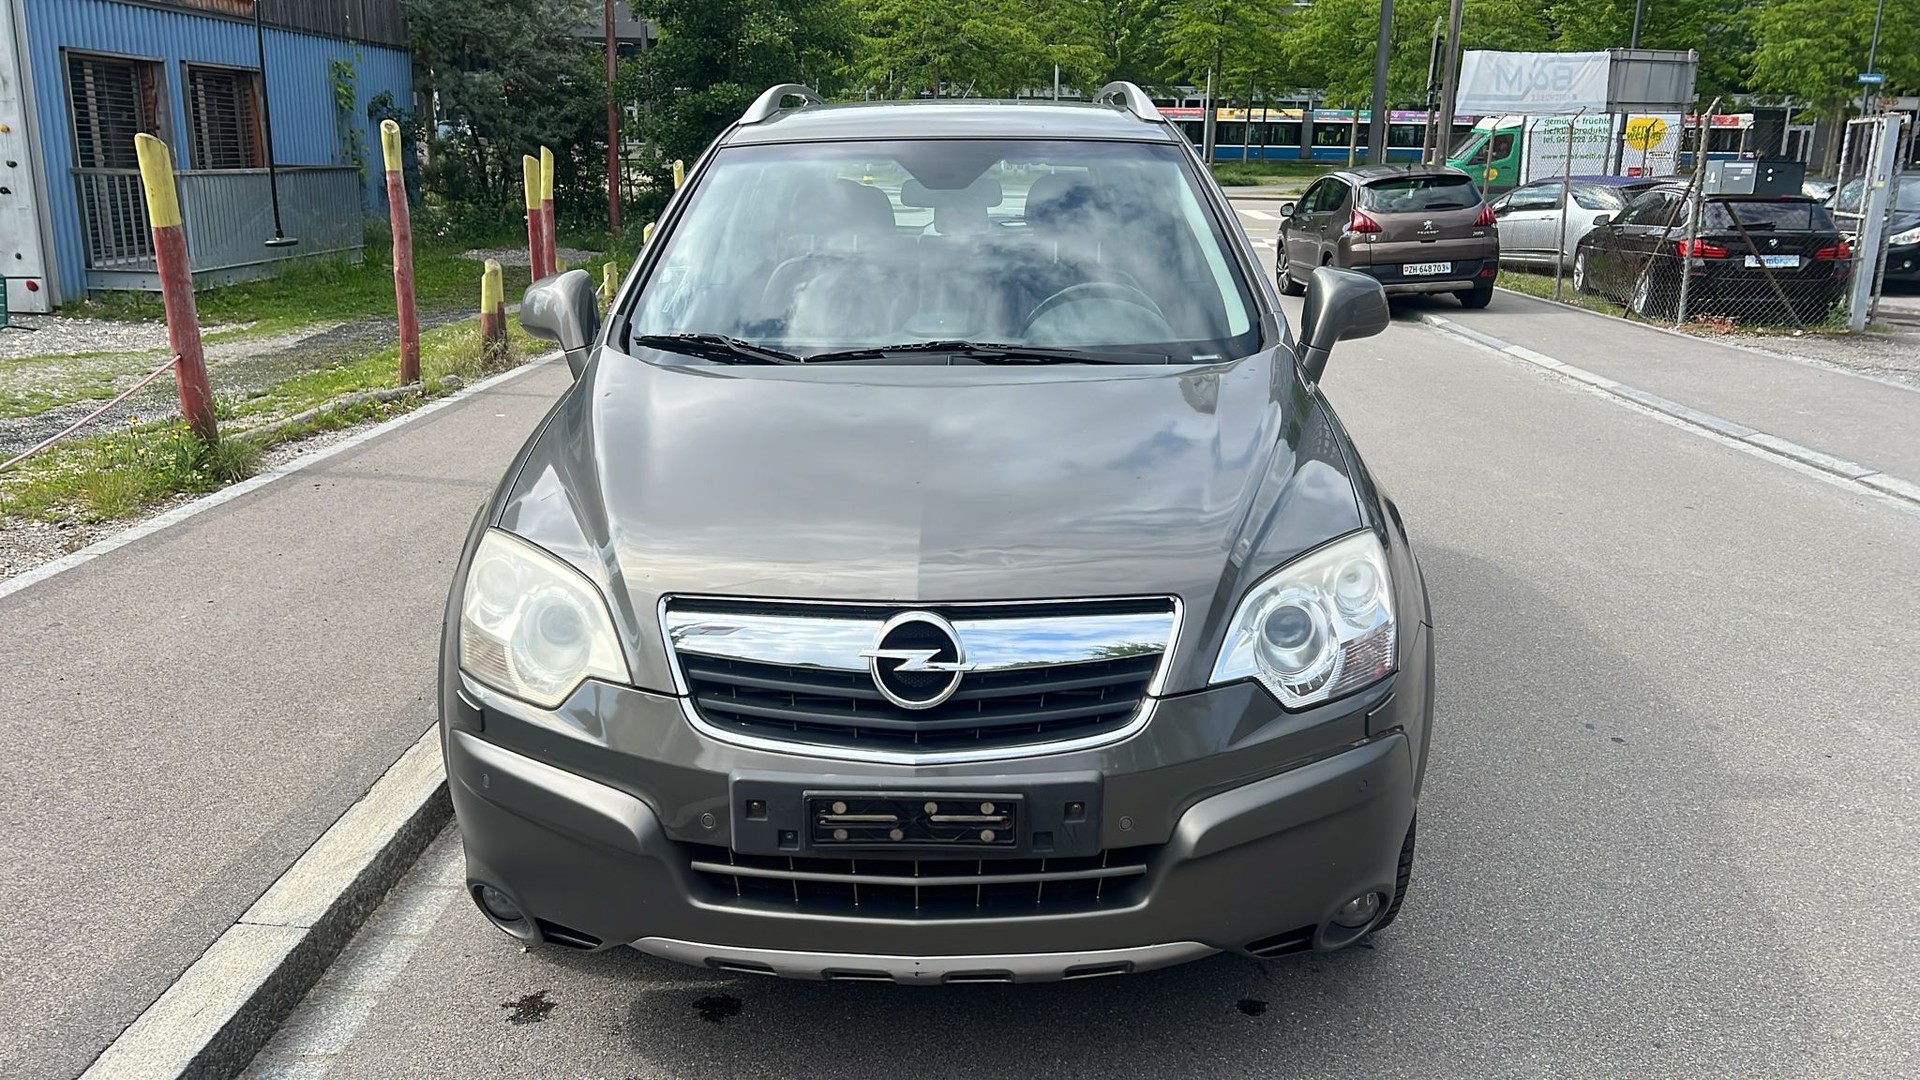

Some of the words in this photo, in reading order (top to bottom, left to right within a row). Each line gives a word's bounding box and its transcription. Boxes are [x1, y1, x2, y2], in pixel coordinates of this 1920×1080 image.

[1544, 117, 1570, 127] gemüs
[1631, 124, 1656, 132] ernt
[1409, 265, 1418, 274] ZH
[1419, 264, 1446, 273] 648703
